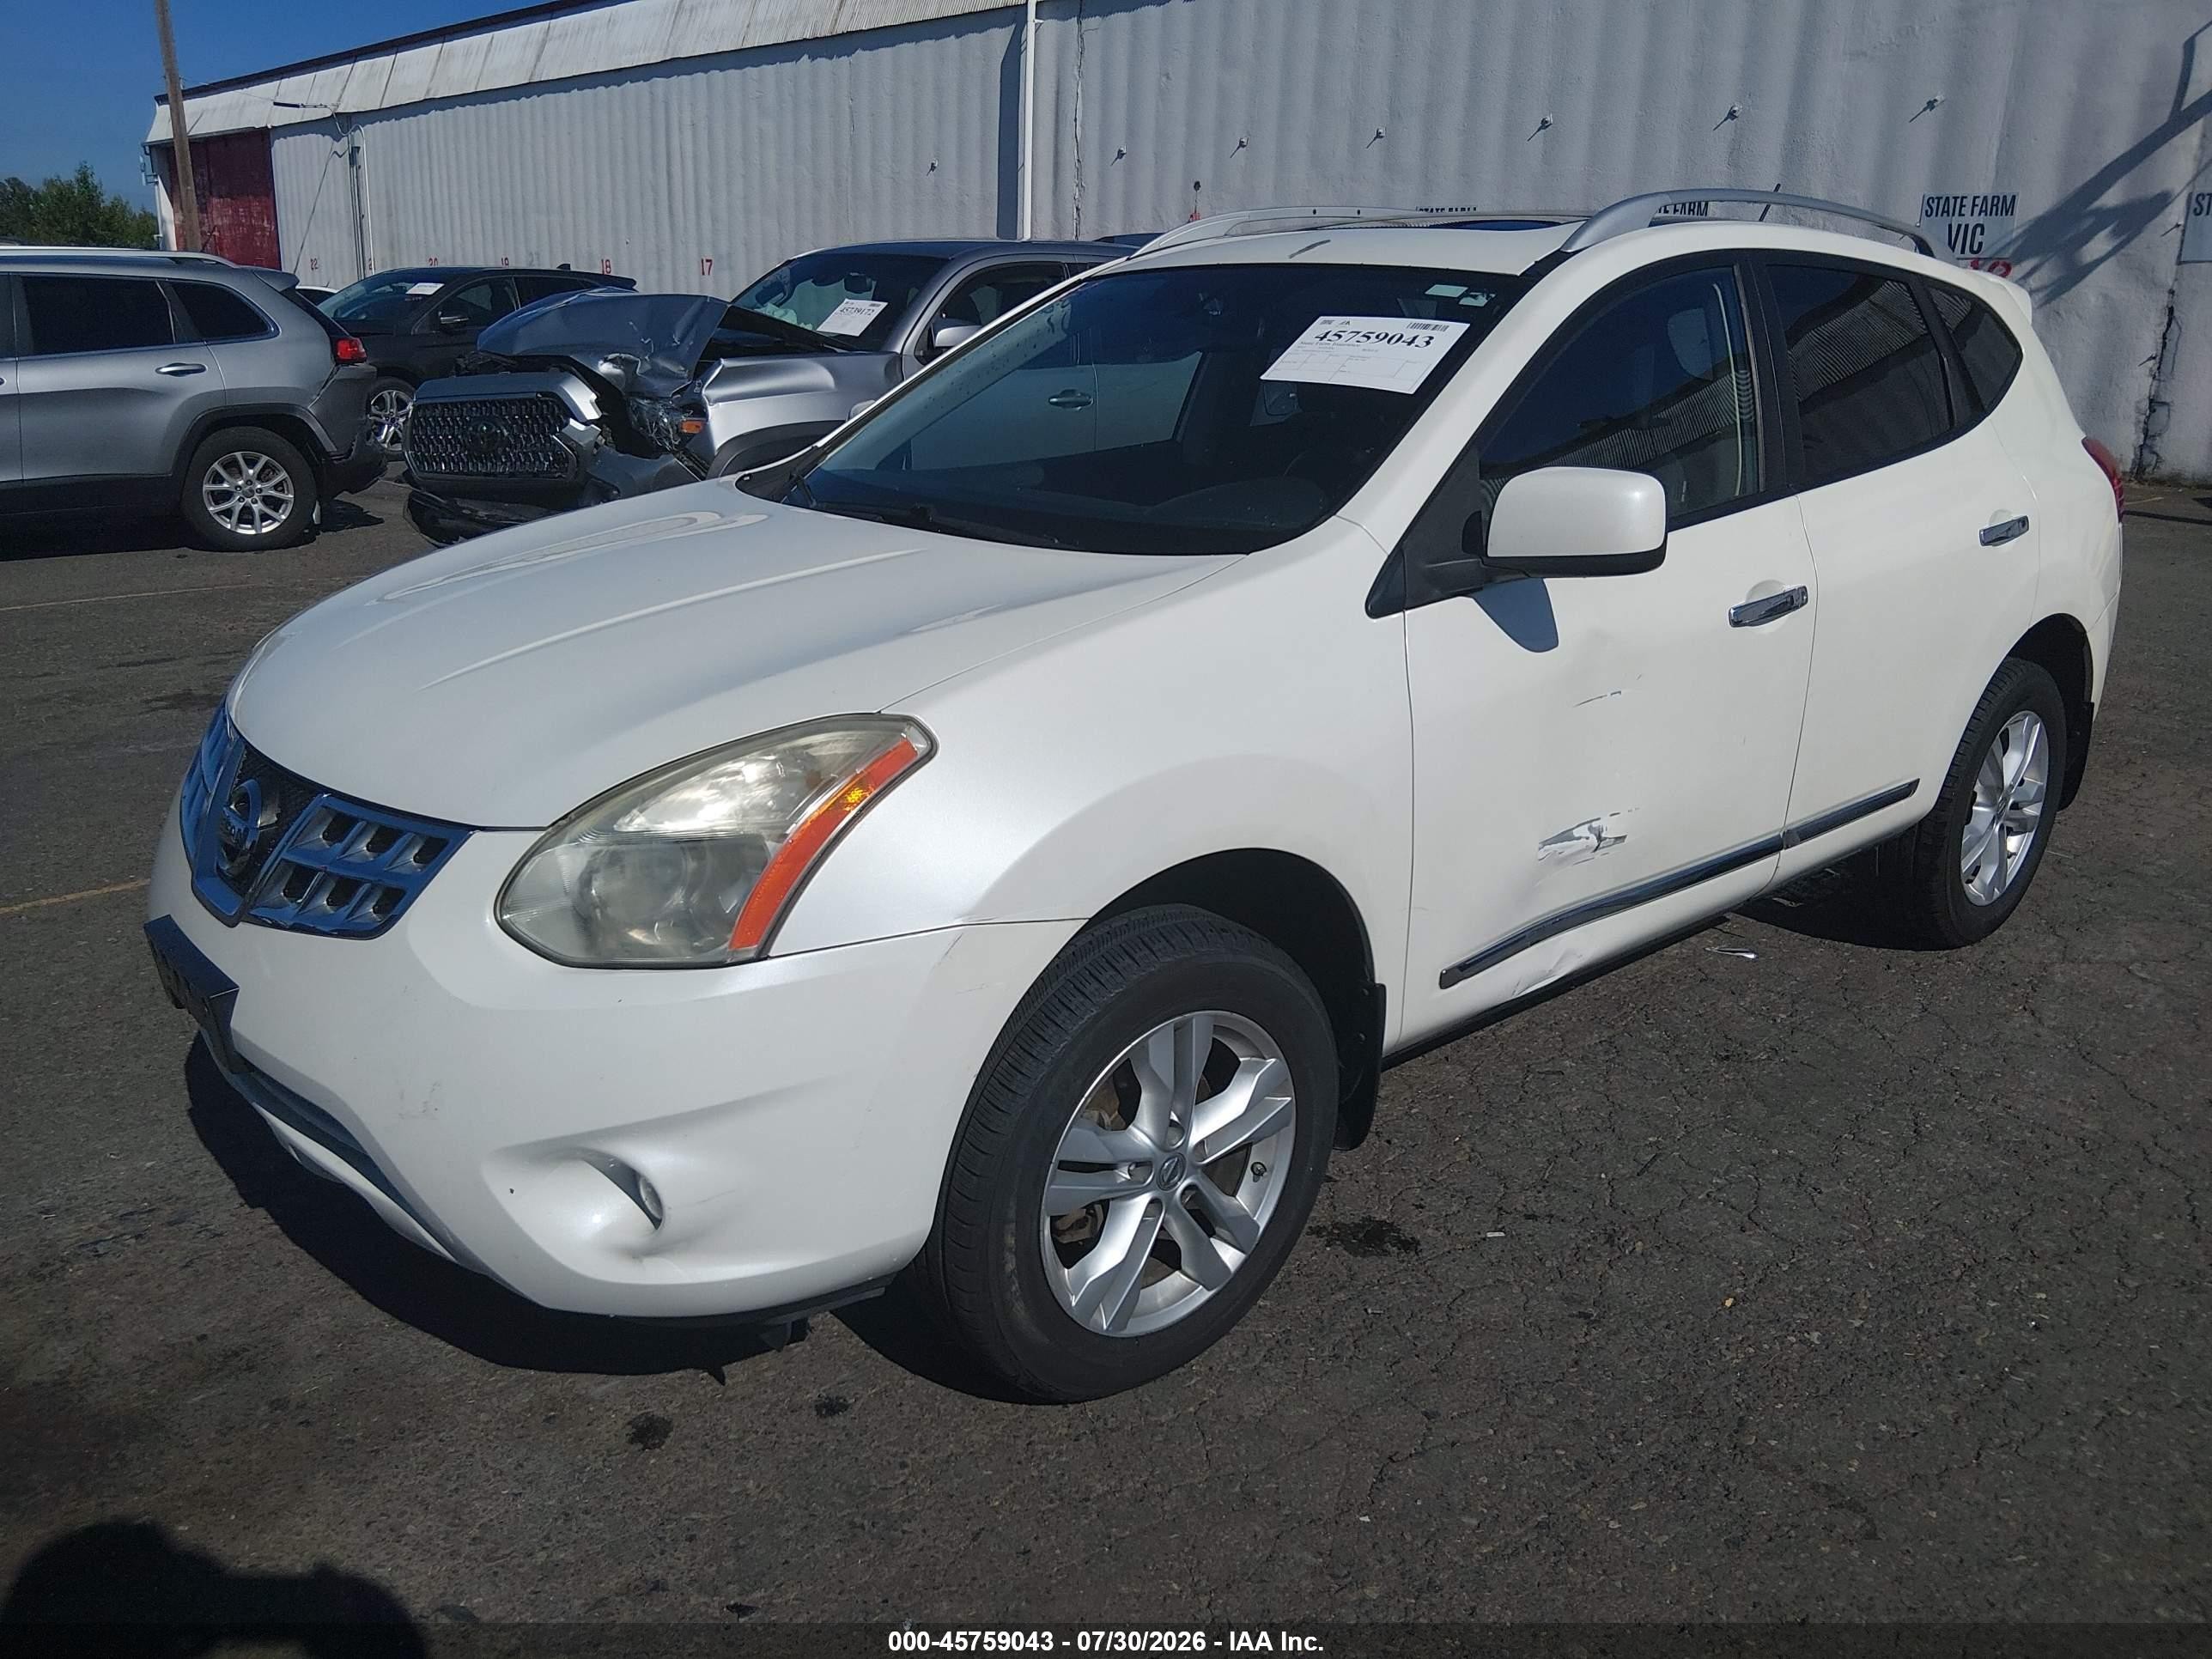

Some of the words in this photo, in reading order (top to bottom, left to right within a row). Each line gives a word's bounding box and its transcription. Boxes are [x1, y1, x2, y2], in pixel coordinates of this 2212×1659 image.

[1924, 195, 1968, 217] STATE
[1970, 194, 2017, 217] FARM
[1948, 222, 1985, 255] VIC
[601, 258, 612, 274] 18
[701, 258, 713, 276] 17
[1315, 330, 1435, 349] 45759043
